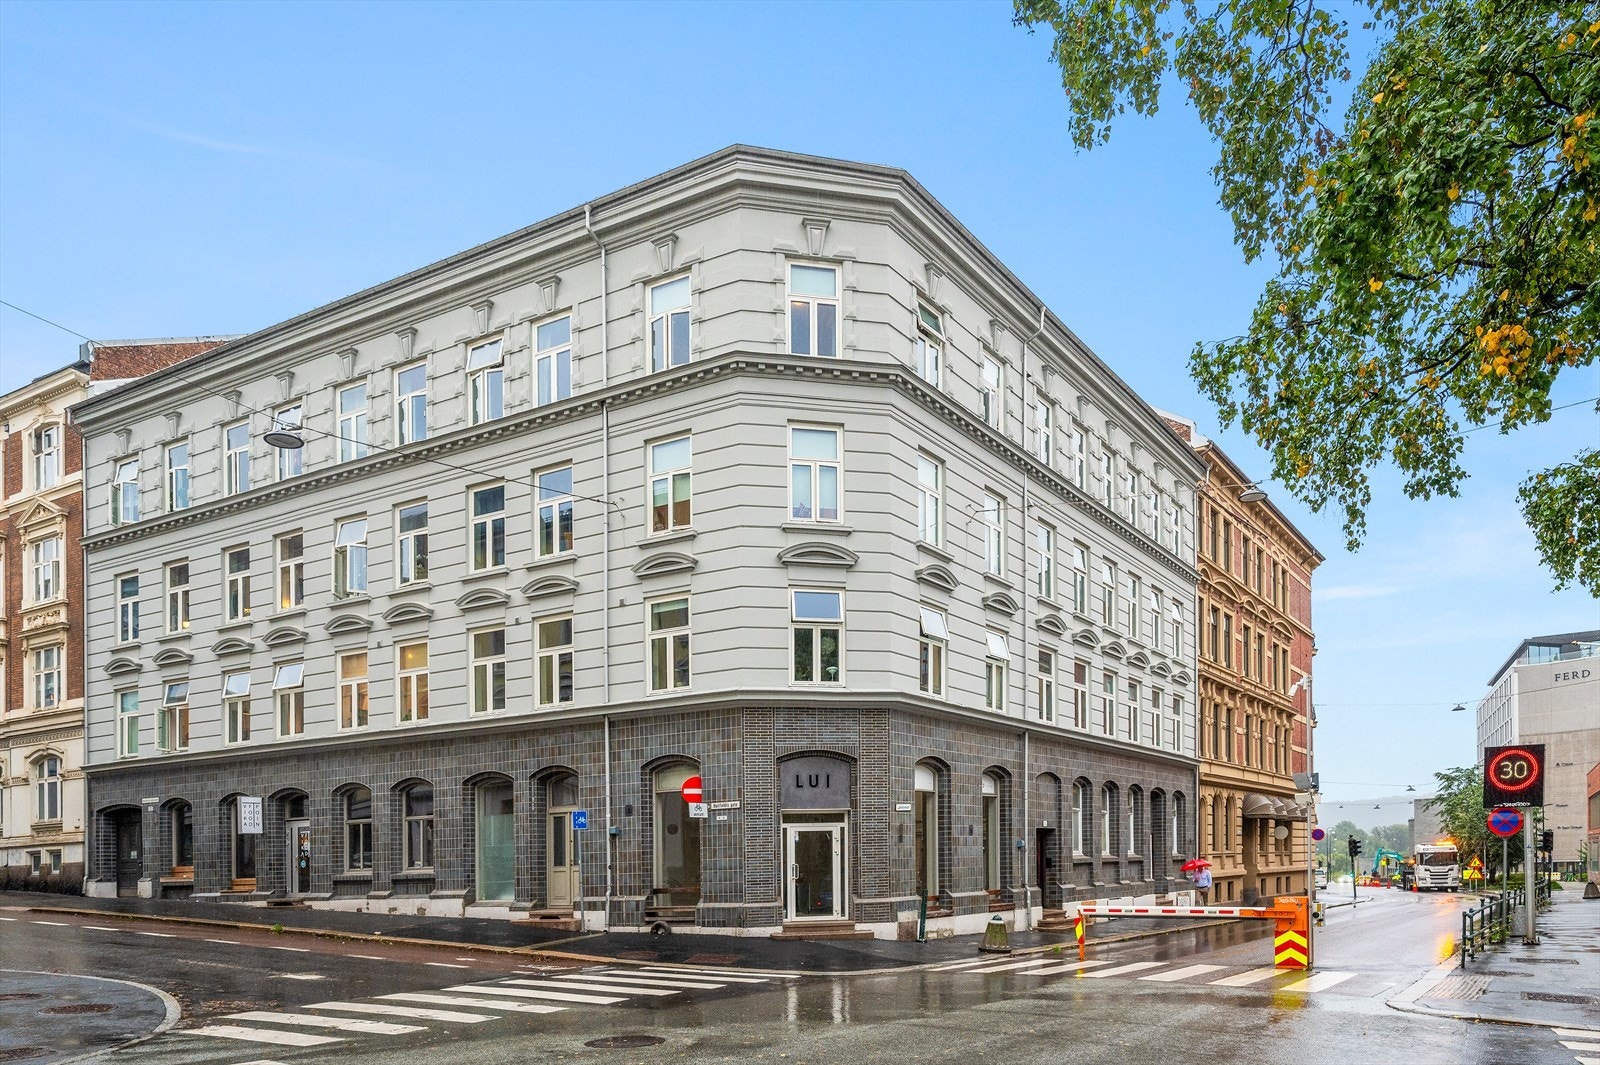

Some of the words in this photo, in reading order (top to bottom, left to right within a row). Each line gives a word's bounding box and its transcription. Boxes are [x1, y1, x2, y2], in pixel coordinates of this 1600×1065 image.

[1555, 670, 1591, 681] FERD
[1500, 761, 1527, 778] 30
[796, 775, 829, 788] LUI
